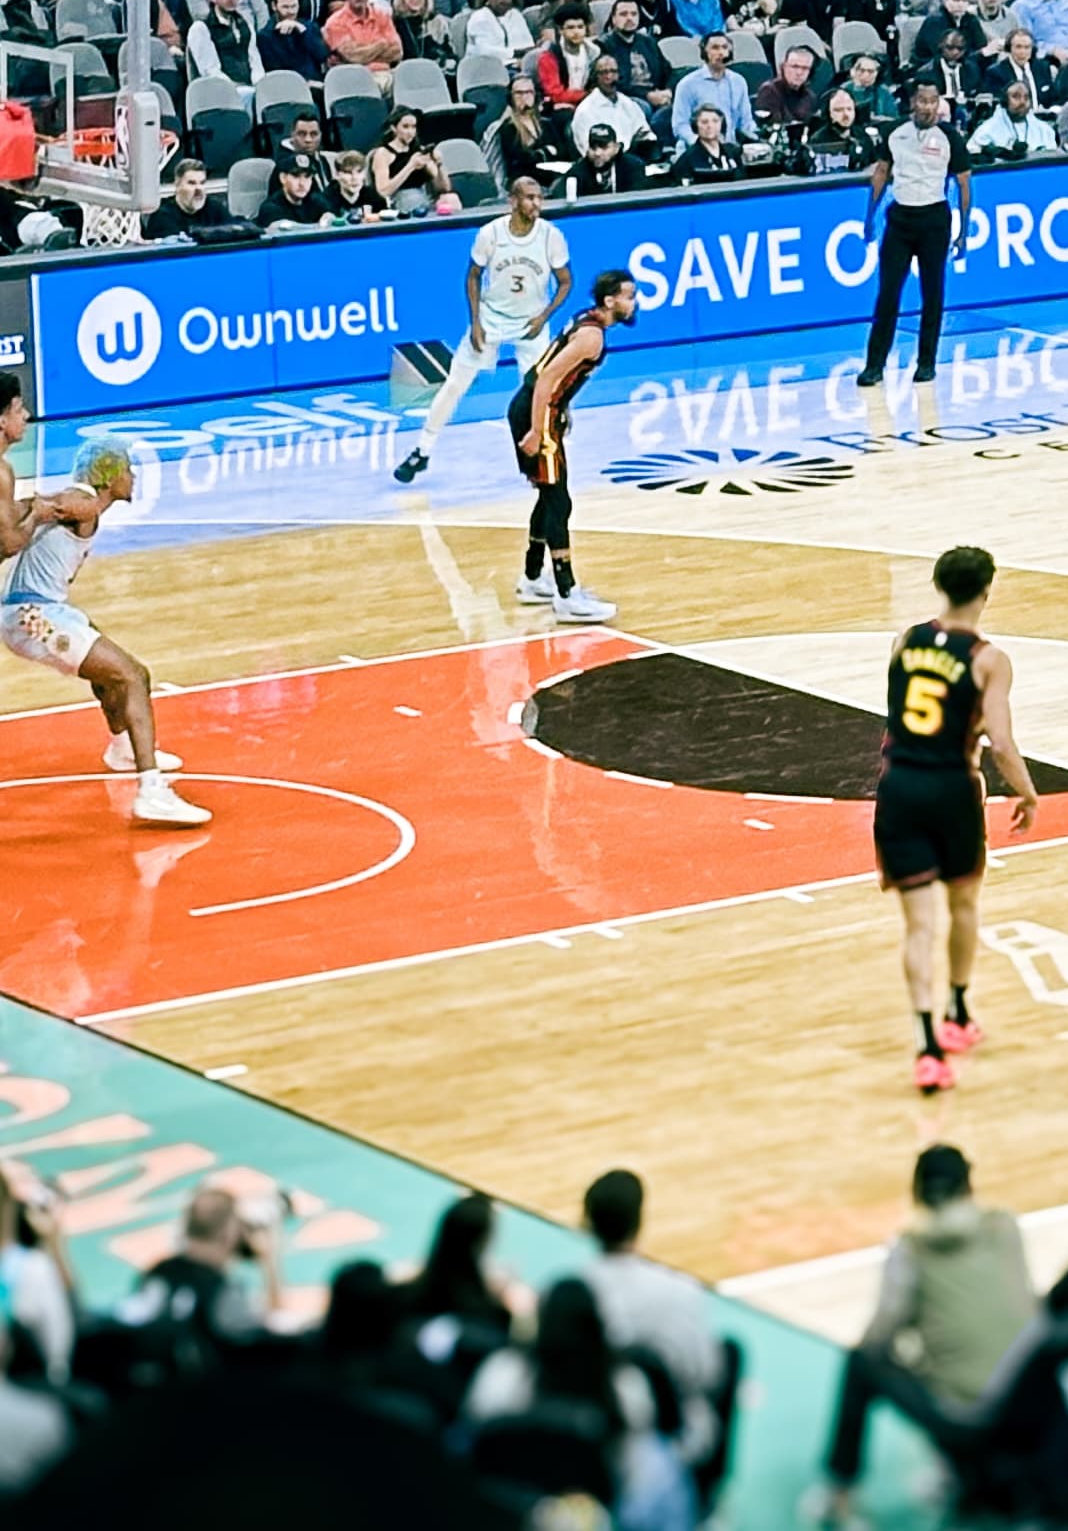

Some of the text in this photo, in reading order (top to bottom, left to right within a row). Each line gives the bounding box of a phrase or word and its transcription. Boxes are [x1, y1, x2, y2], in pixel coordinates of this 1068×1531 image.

[510, 275, 525, 293] 3
[629, 226, 805, 311] SAVE
[178, 285, 399, 354] Ownwell
[902, 675, 948, 737] 5
